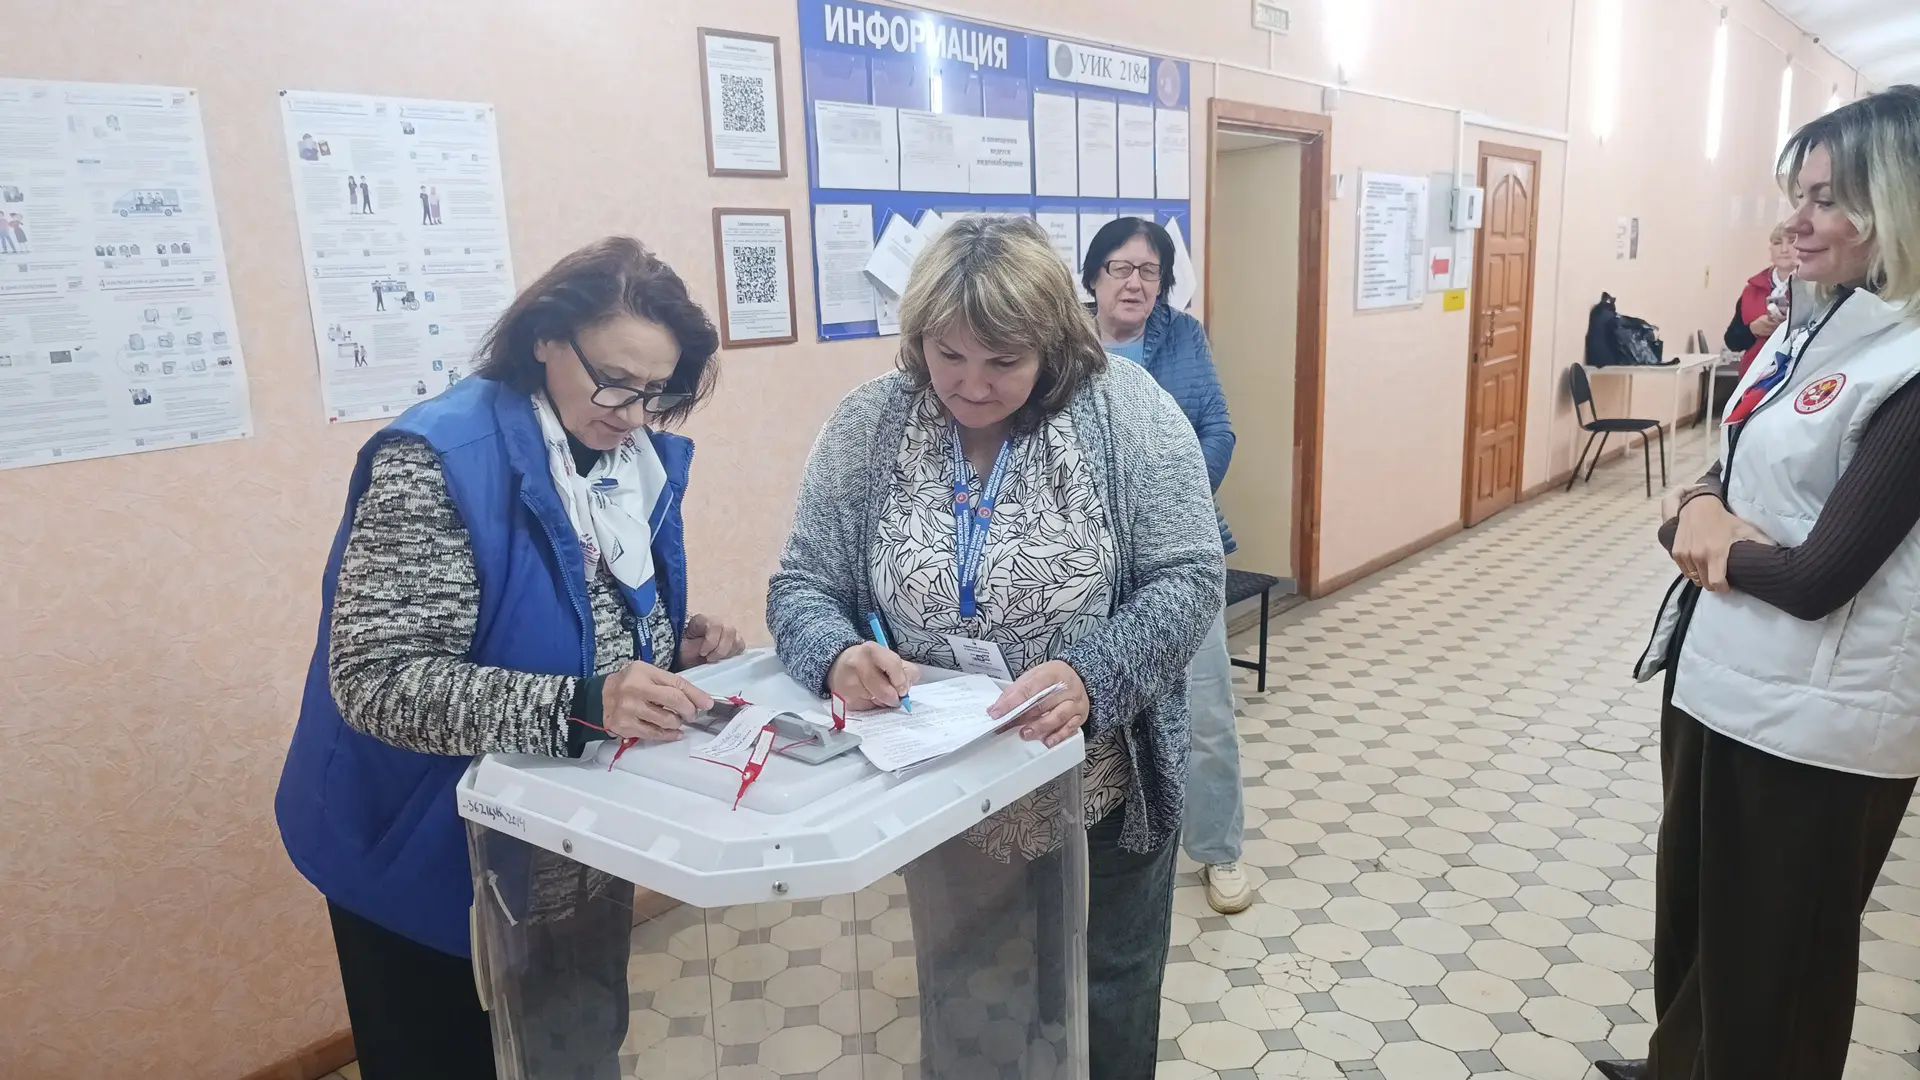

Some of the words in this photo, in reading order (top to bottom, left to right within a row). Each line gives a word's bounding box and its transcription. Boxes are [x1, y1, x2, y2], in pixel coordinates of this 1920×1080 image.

[824, 4, 1008, 71] ИНФОРМАЦИЯ
[1079, 52, 1112, 79] УИК
[1119, 60, 1148, 85] 2184
